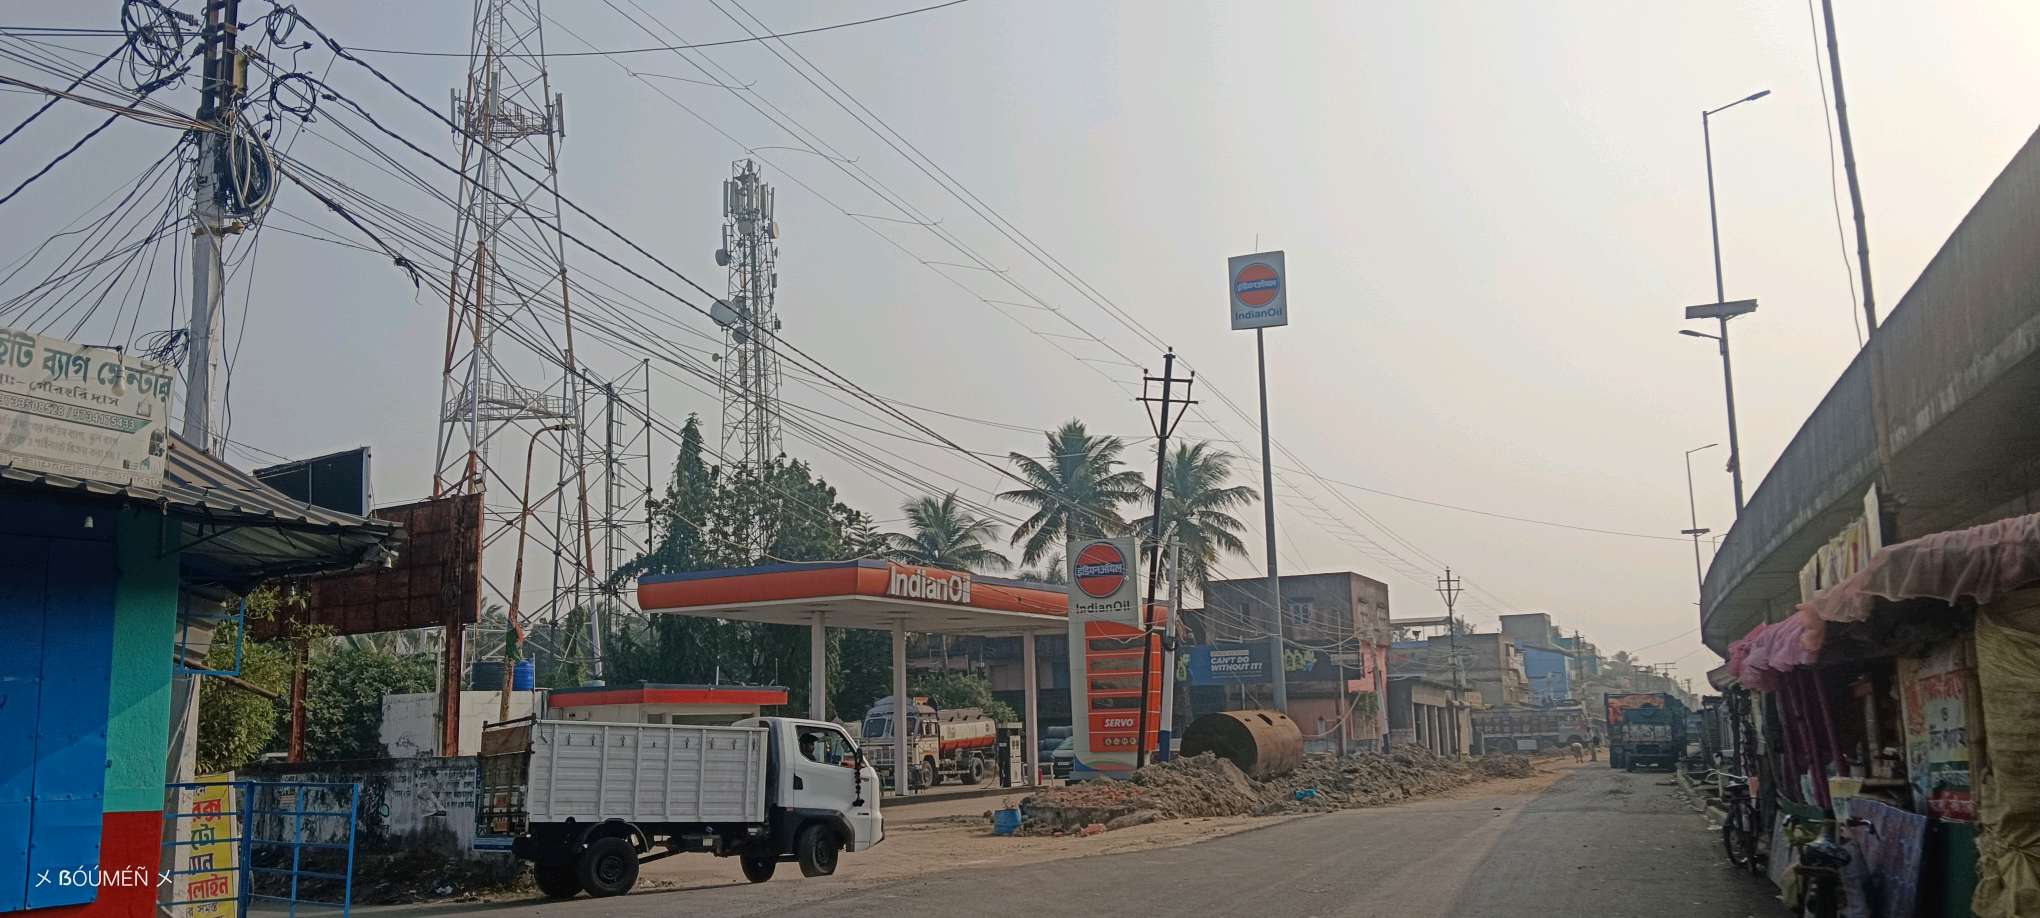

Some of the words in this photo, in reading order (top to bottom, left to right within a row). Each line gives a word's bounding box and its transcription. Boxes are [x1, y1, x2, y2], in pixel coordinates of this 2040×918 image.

[1235, 307, 1282, 320] IndianOil
[888, 565, 971, 603] IndianOil
[1076, 600, 1130, 614] IndianOil
[1237, 656, 1250, 664] DO
[1211, 663, 1250, 672] WITHOUT
[1104, 718, 1134, 728] SERVO
